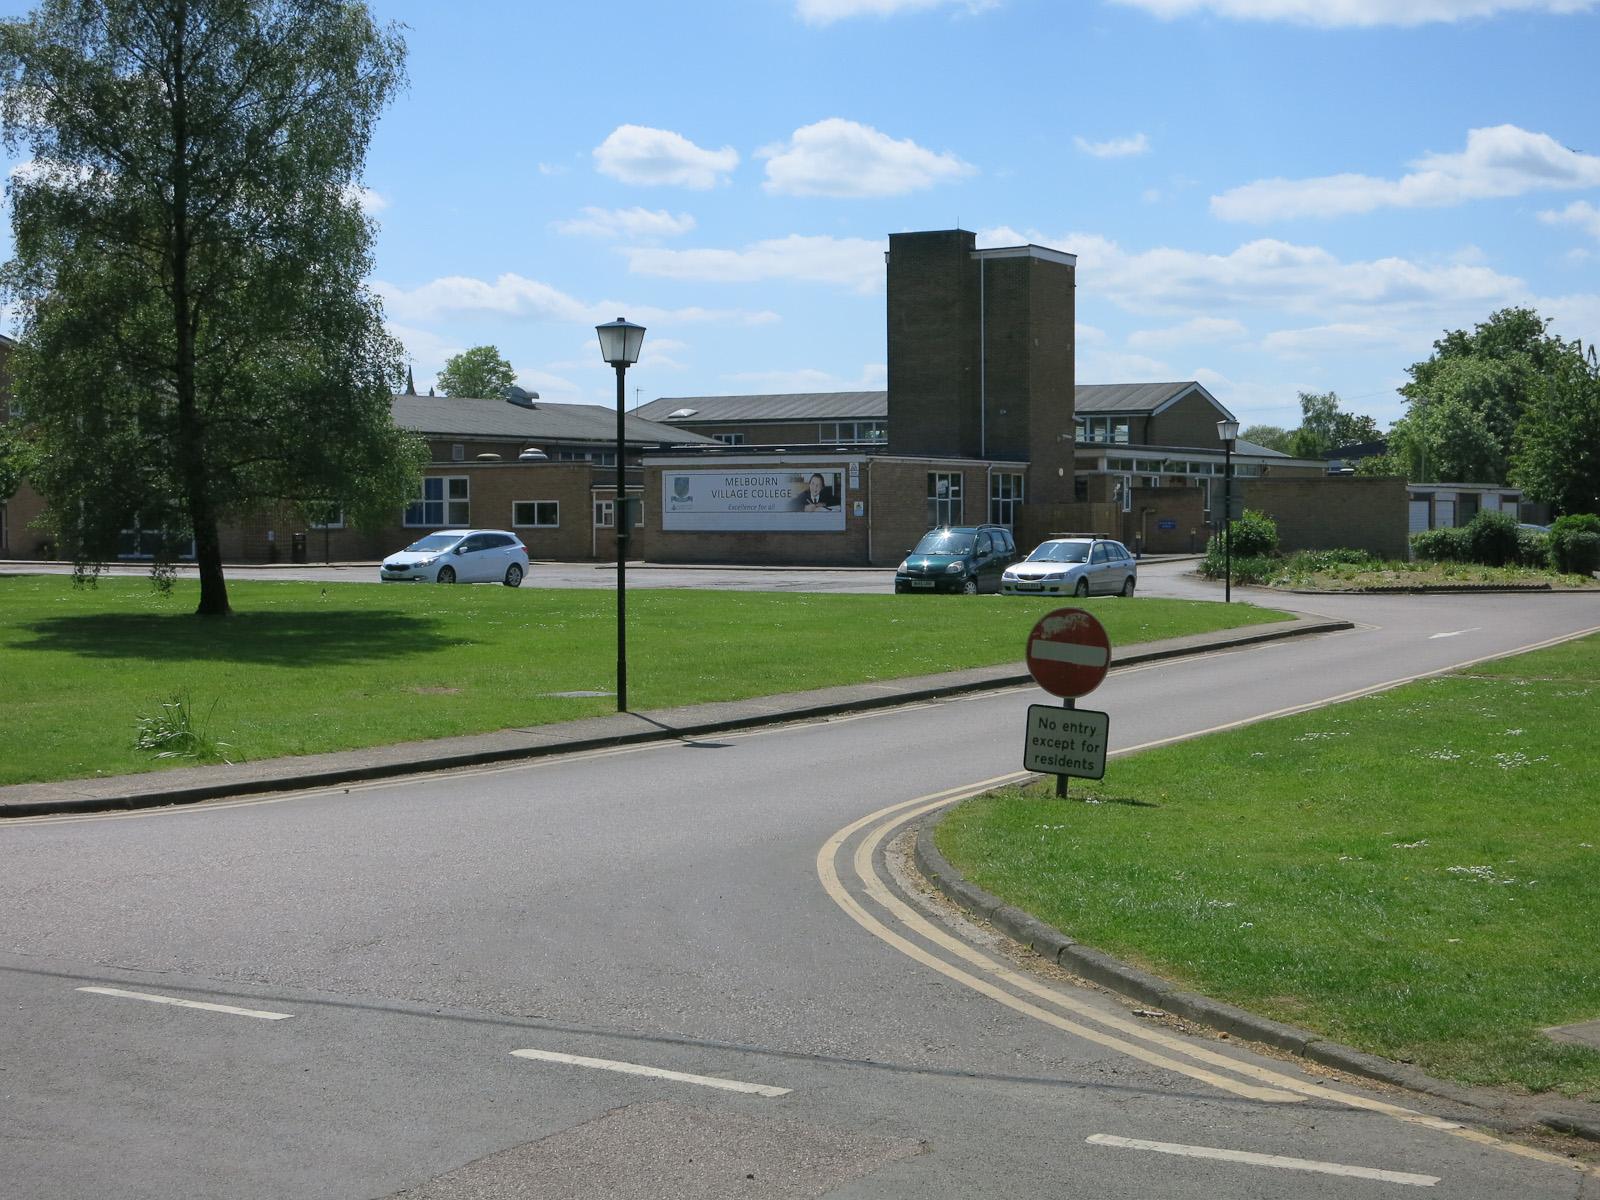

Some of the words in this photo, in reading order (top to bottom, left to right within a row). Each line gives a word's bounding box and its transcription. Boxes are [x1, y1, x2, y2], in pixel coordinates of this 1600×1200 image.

[725, 477, 778, 486] MELBOURN
[711, 489, 748, 498] VILLAGE
[751, 489, 792, 498] COLLEGE
[727, 503, 757, 511] Excellence
[758, 503, 767, 512] for
[1038, 717, 1056, 730] No
[1062, 721, 1096, 737] entry
[1032, 736, 1075, 751] except
[1081, 740, 1100, 753] for
[1034, 754, 1095, 770] residents
